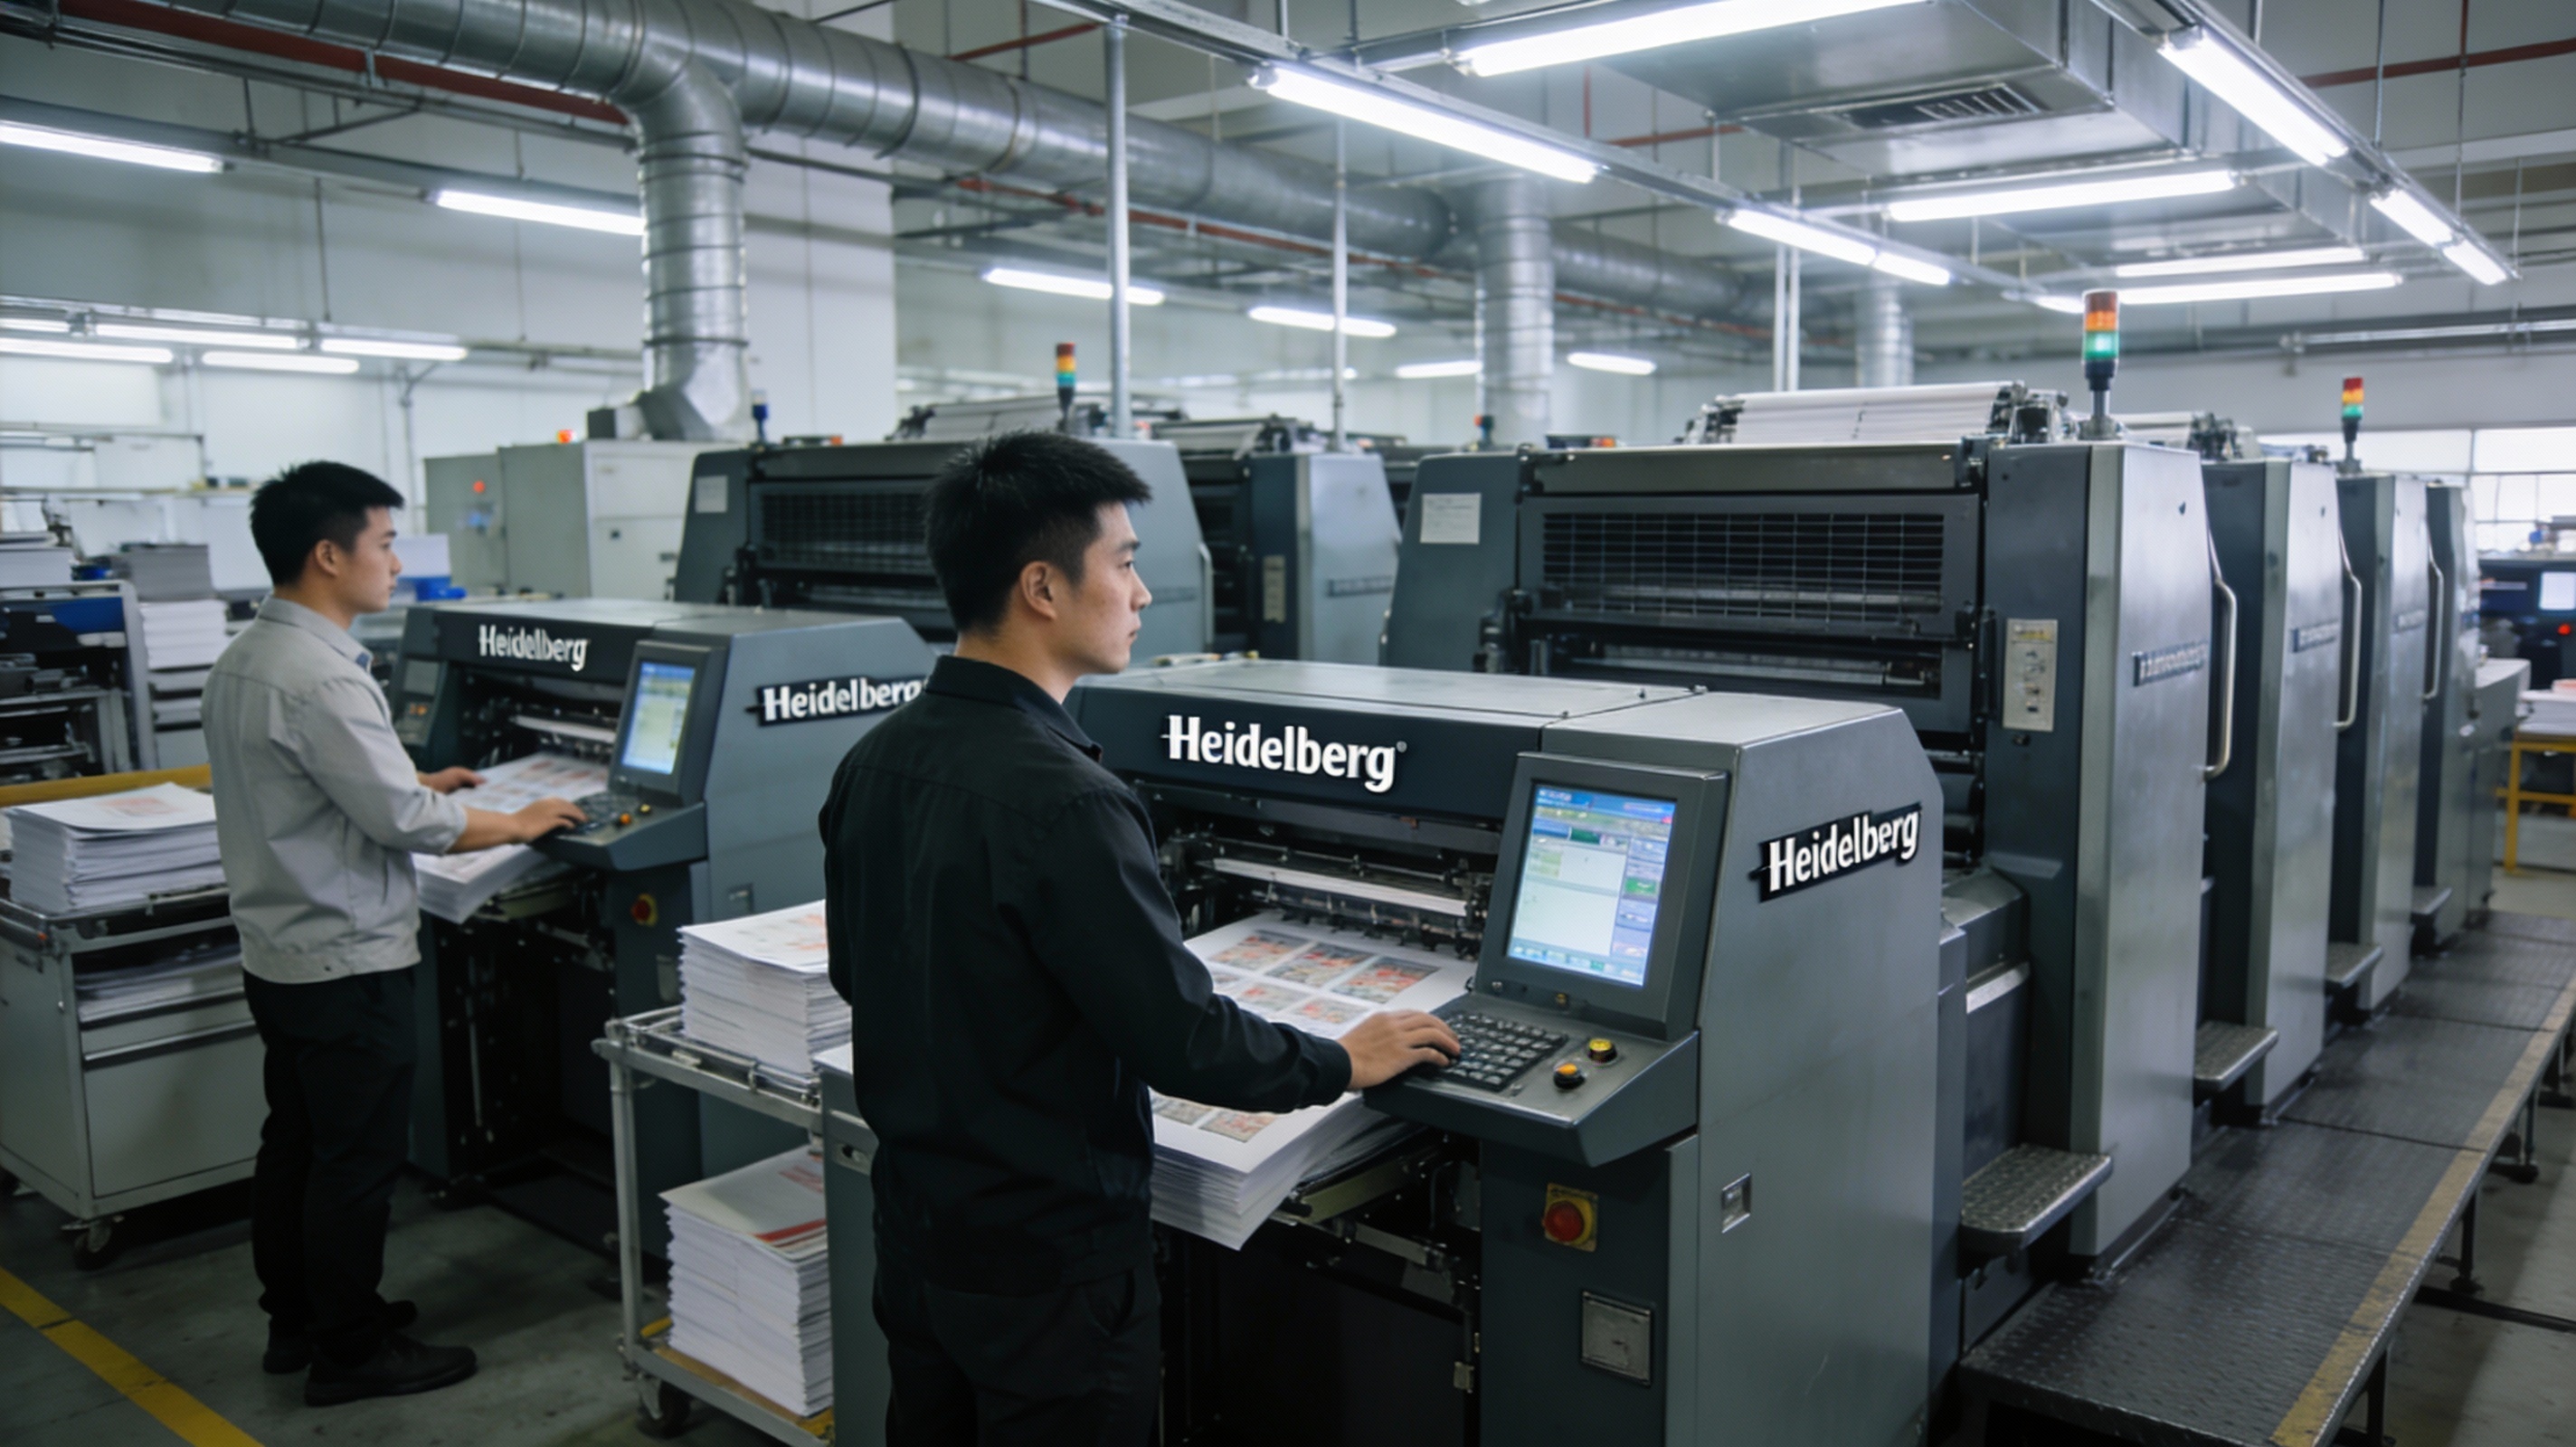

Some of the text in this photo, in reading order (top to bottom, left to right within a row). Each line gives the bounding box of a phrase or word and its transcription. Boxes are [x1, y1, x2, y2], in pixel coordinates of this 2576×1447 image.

[479, 624, 587, 671] Heidelberg
[1169, 714, 1396, 793] Heidelberg
[1769, 811, 1919, 893] Heidelberg
